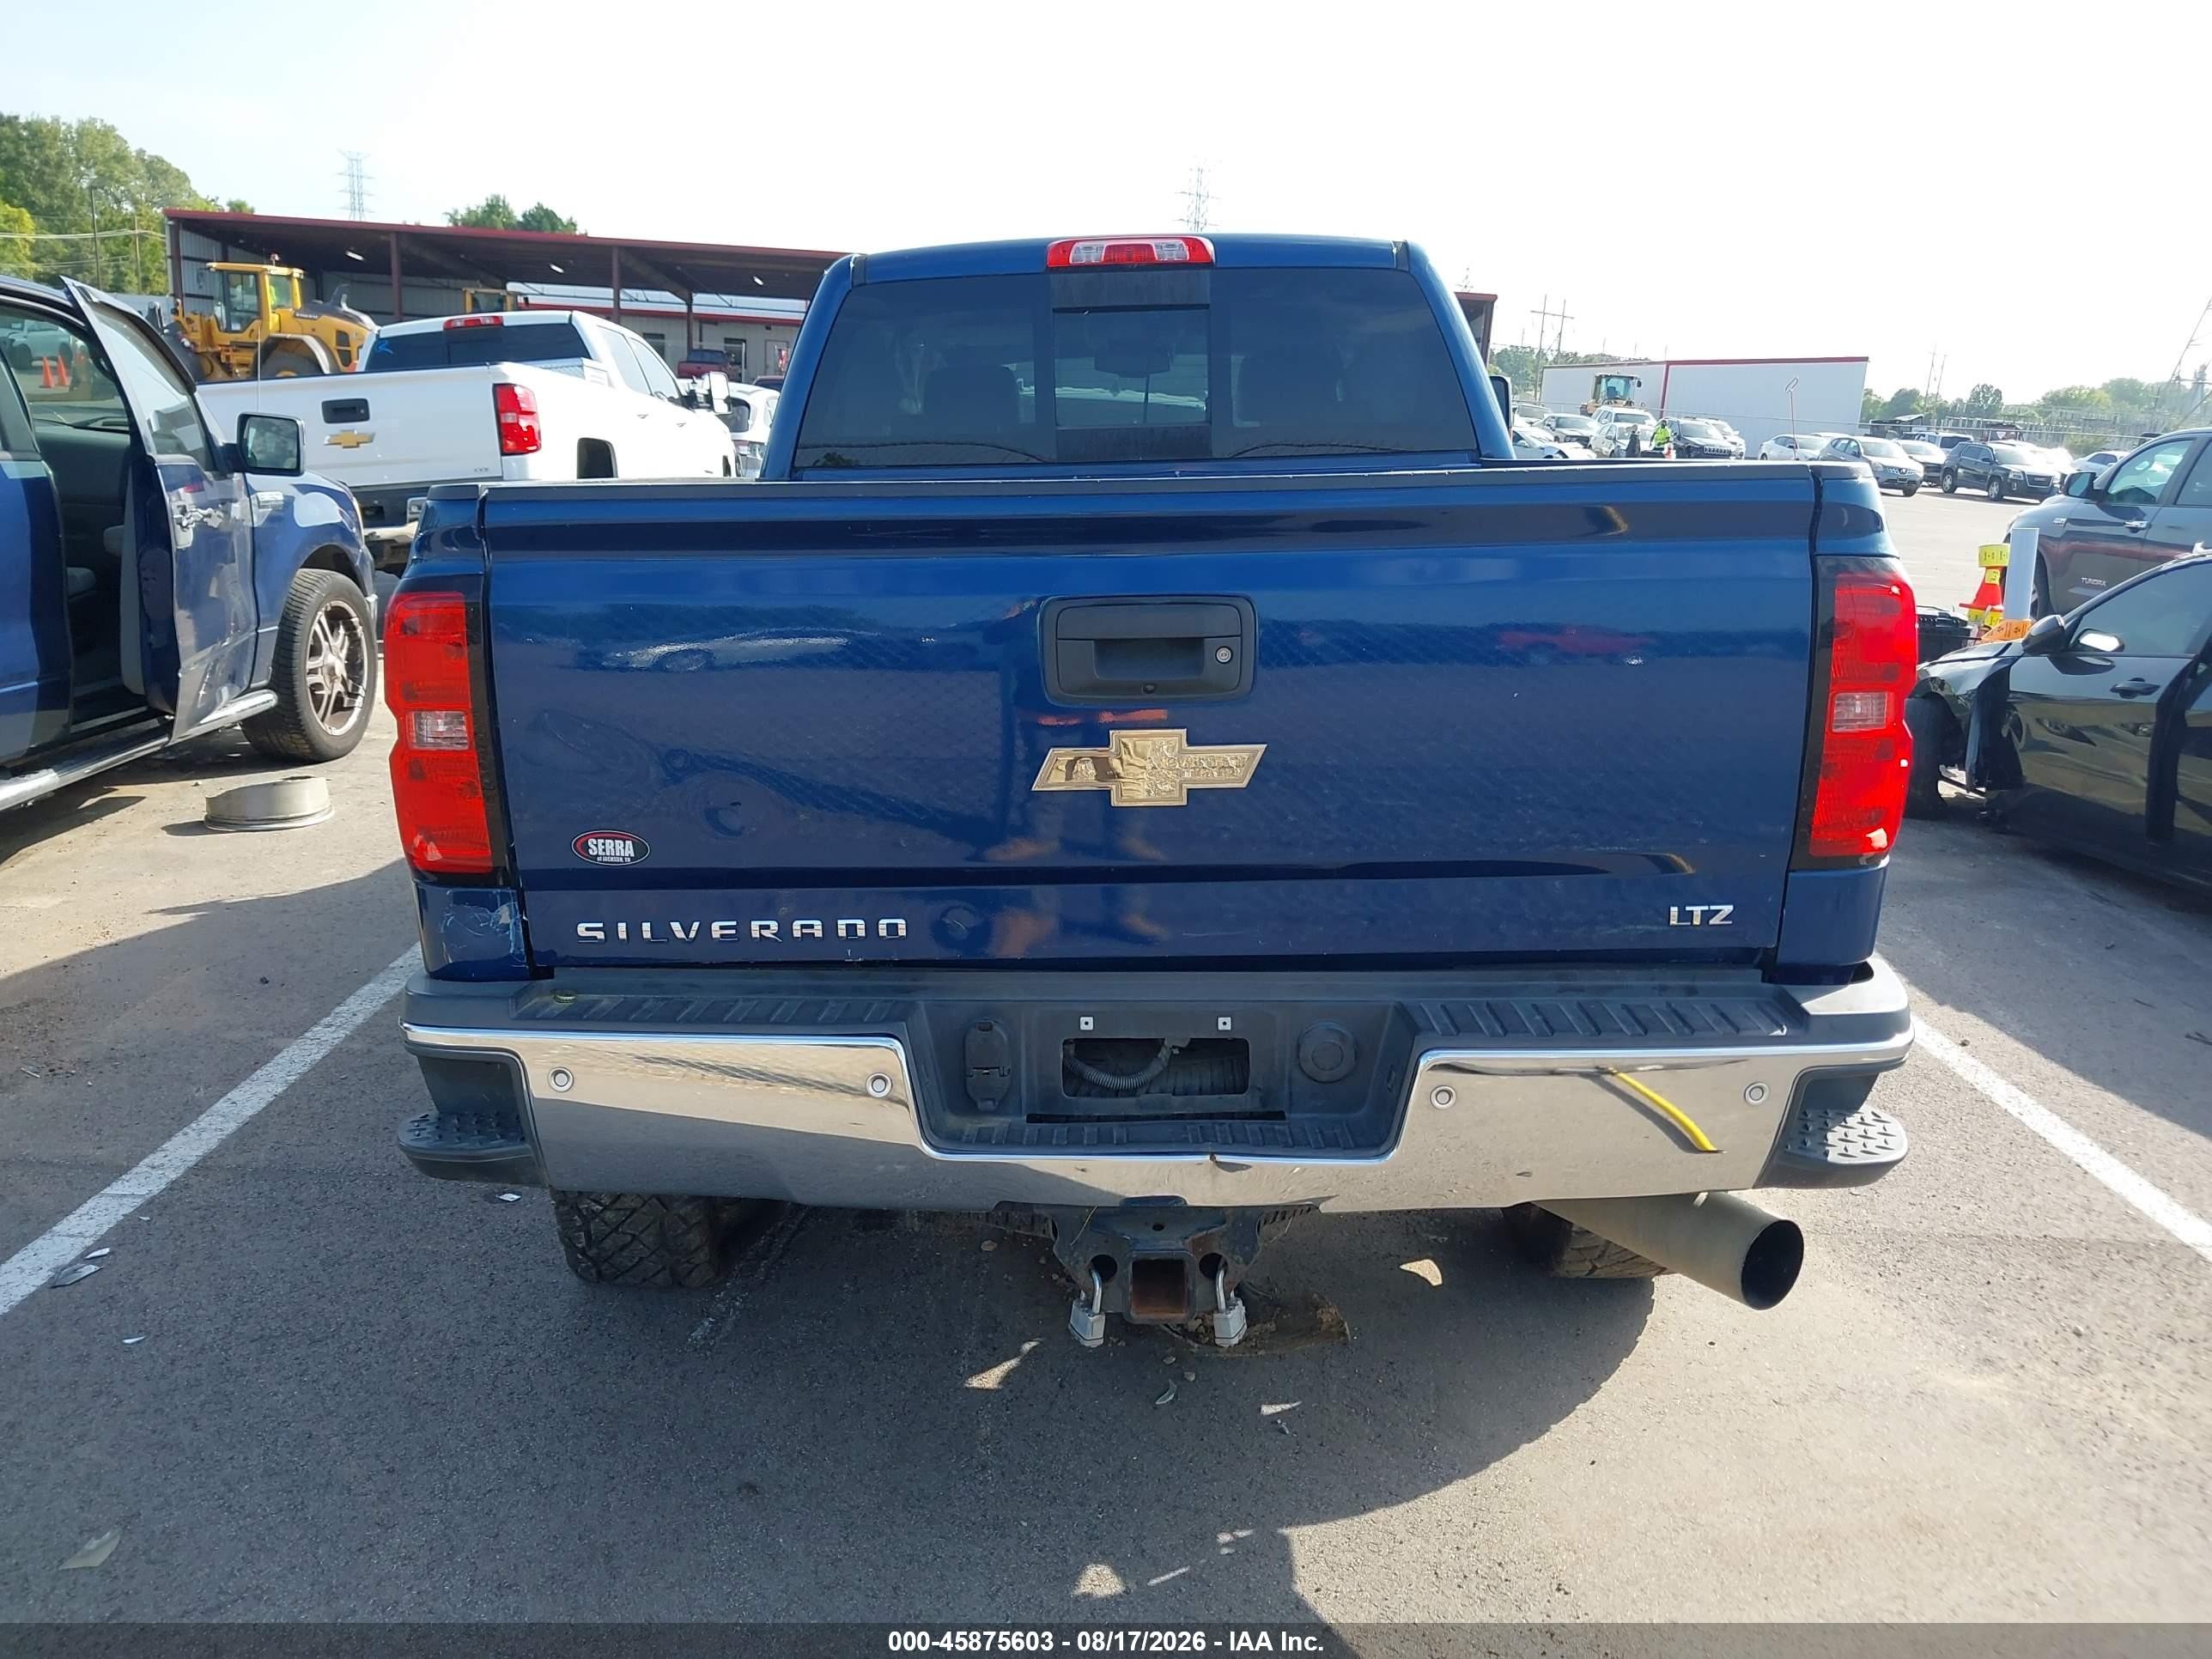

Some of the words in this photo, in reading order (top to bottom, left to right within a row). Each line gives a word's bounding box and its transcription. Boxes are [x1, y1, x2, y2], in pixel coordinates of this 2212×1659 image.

[587, 838, 635, 857] SERRA
[1669, 904, 1734, 926] LTZ
[576, 918, 908, 943] SILVERADO
